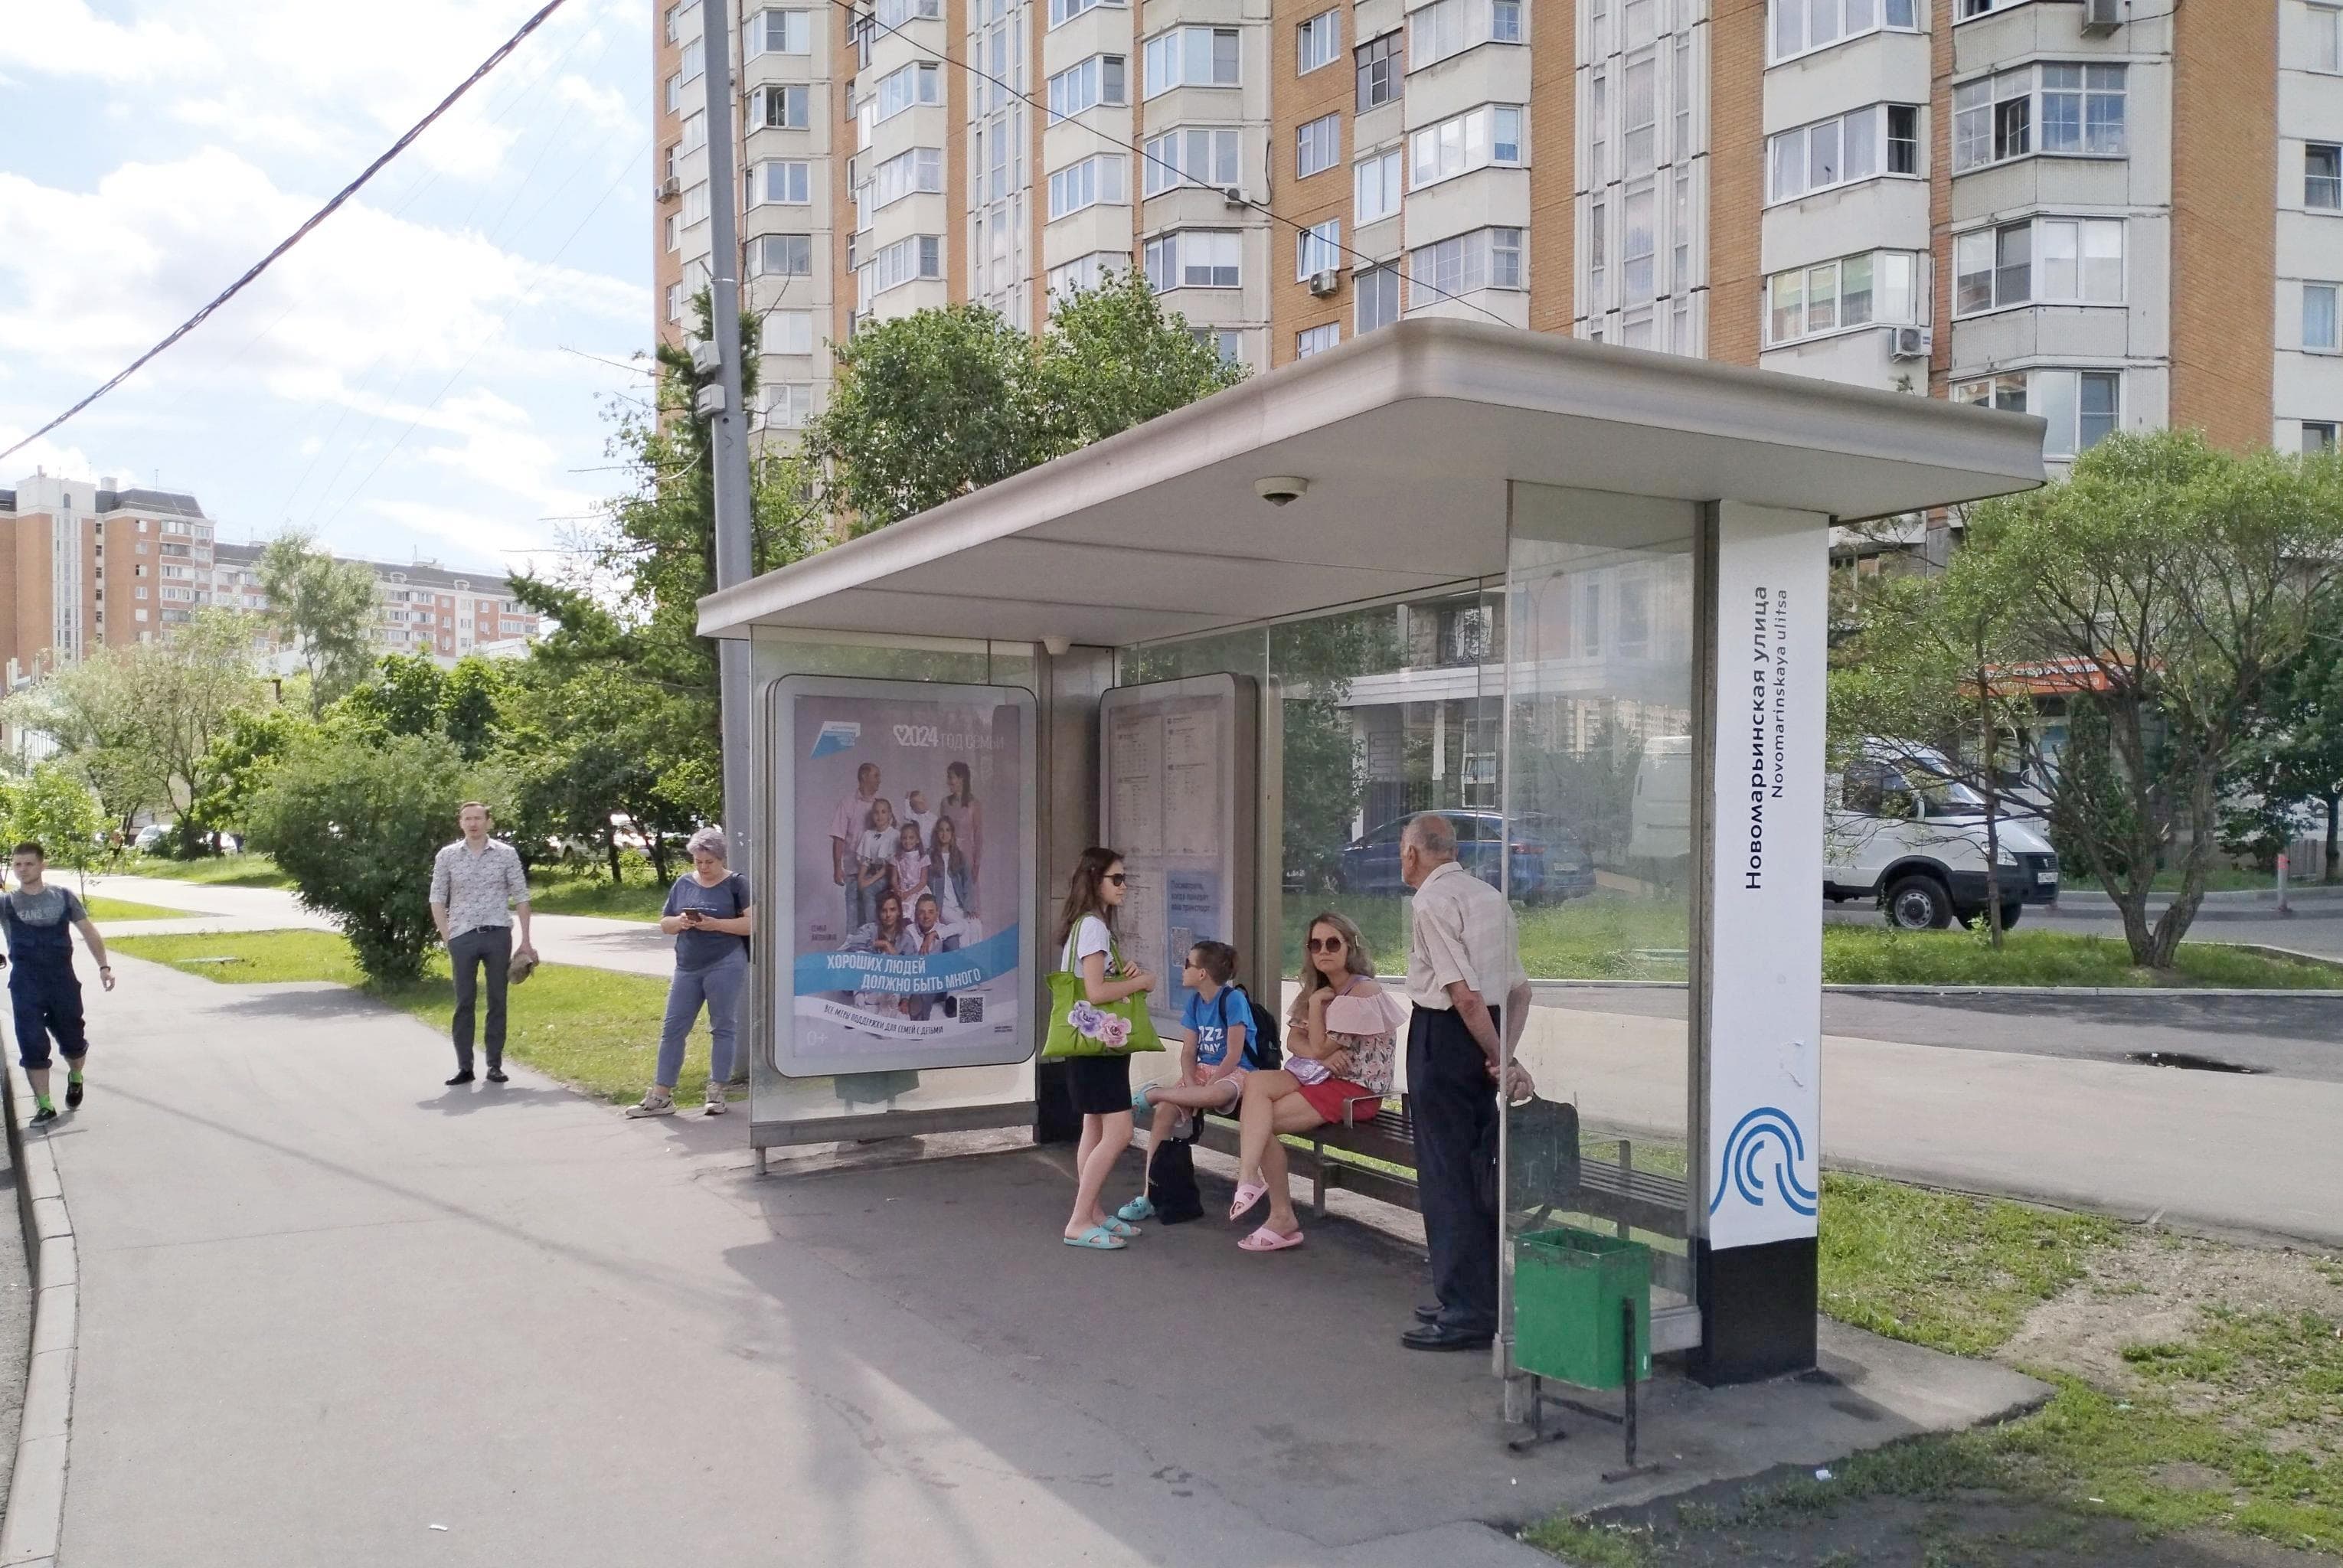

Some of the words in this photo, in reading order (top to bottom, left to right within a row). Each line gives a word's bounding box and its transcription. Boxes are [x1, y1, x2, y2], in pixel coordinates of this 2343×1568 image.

[1753, 586, 1769, 662] улица
[1774, 590, 1786, 639] ulitsa
[900, 726, 939, 747] 2024
[1772, 646, 1788, 798] Novomarinskaya
[1746, 670, 1766, 889] Новомарьинская
[827, 955, 882, 972] ХОРОШИХ
[884, 958, 926, 975] ЛЮДЕЙ
[861, 974, 910, 992] ДОЛЖНО
[913, 976, 943, 992] БЫТЬ
[945, 968, 981, 988] МНОГО
[824, 1004, 834, 1013] ВСЕ
[835, 1008, 850, 1019] МЕРЫ
[851, 1013, 884, 1029] ПОДДЕРЖКИ
[884, 1024, 897, 1032] ДЛЯ
[897, 1024, 916, 1034] СЕМЕЙ
[920, 1026, 943, 1034] ДЕТЬМИ
